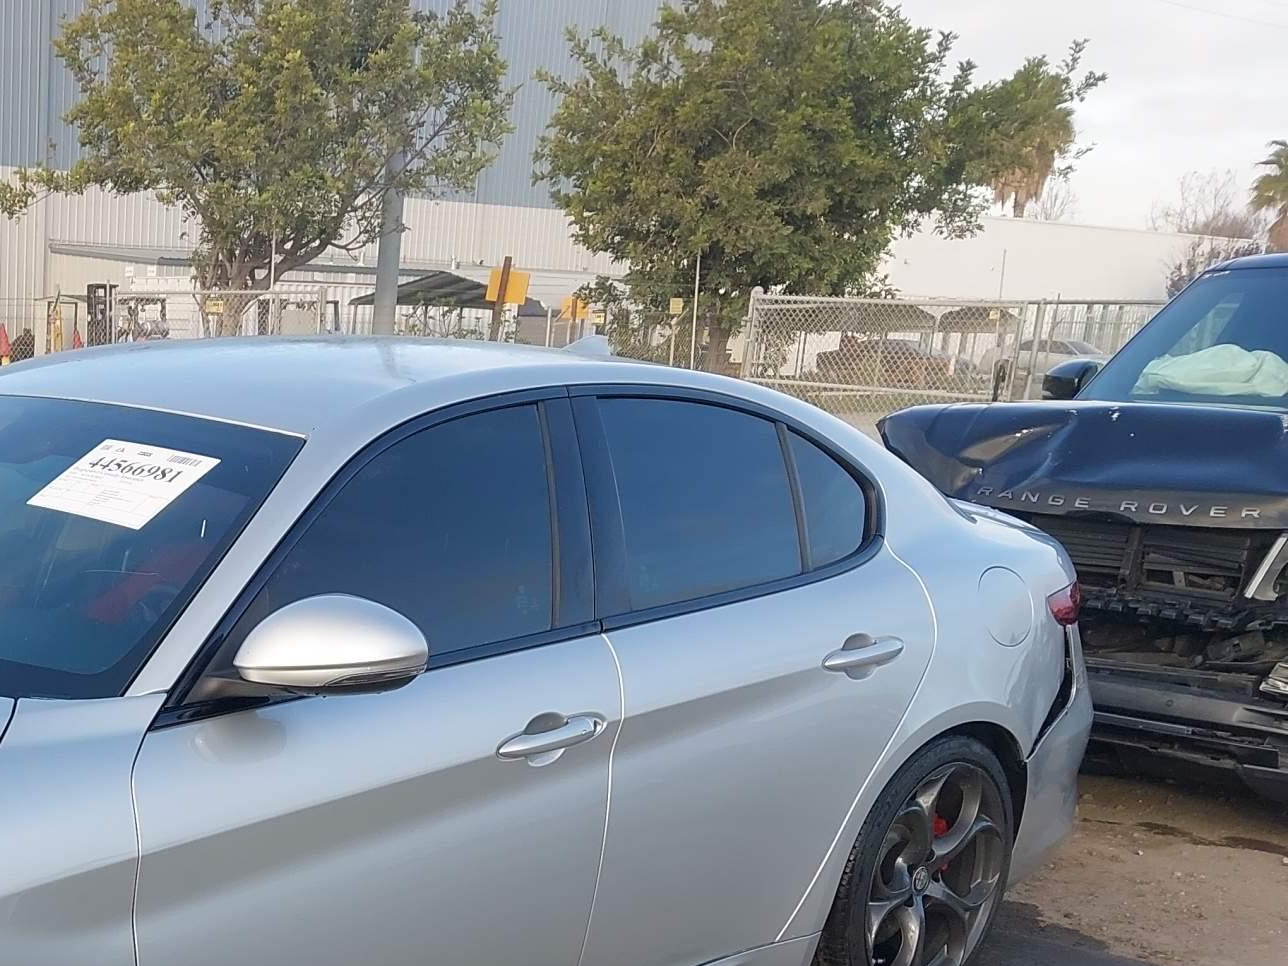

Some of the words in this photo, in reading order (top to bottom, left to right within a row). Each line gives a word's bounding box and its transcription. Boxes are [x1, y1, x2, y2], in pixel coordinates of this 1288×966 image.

[89, 456, 184, 483] 44566981
[976, 486, 1091, 508] RANGE
[1119, 501, 1261, 519] ROVER
